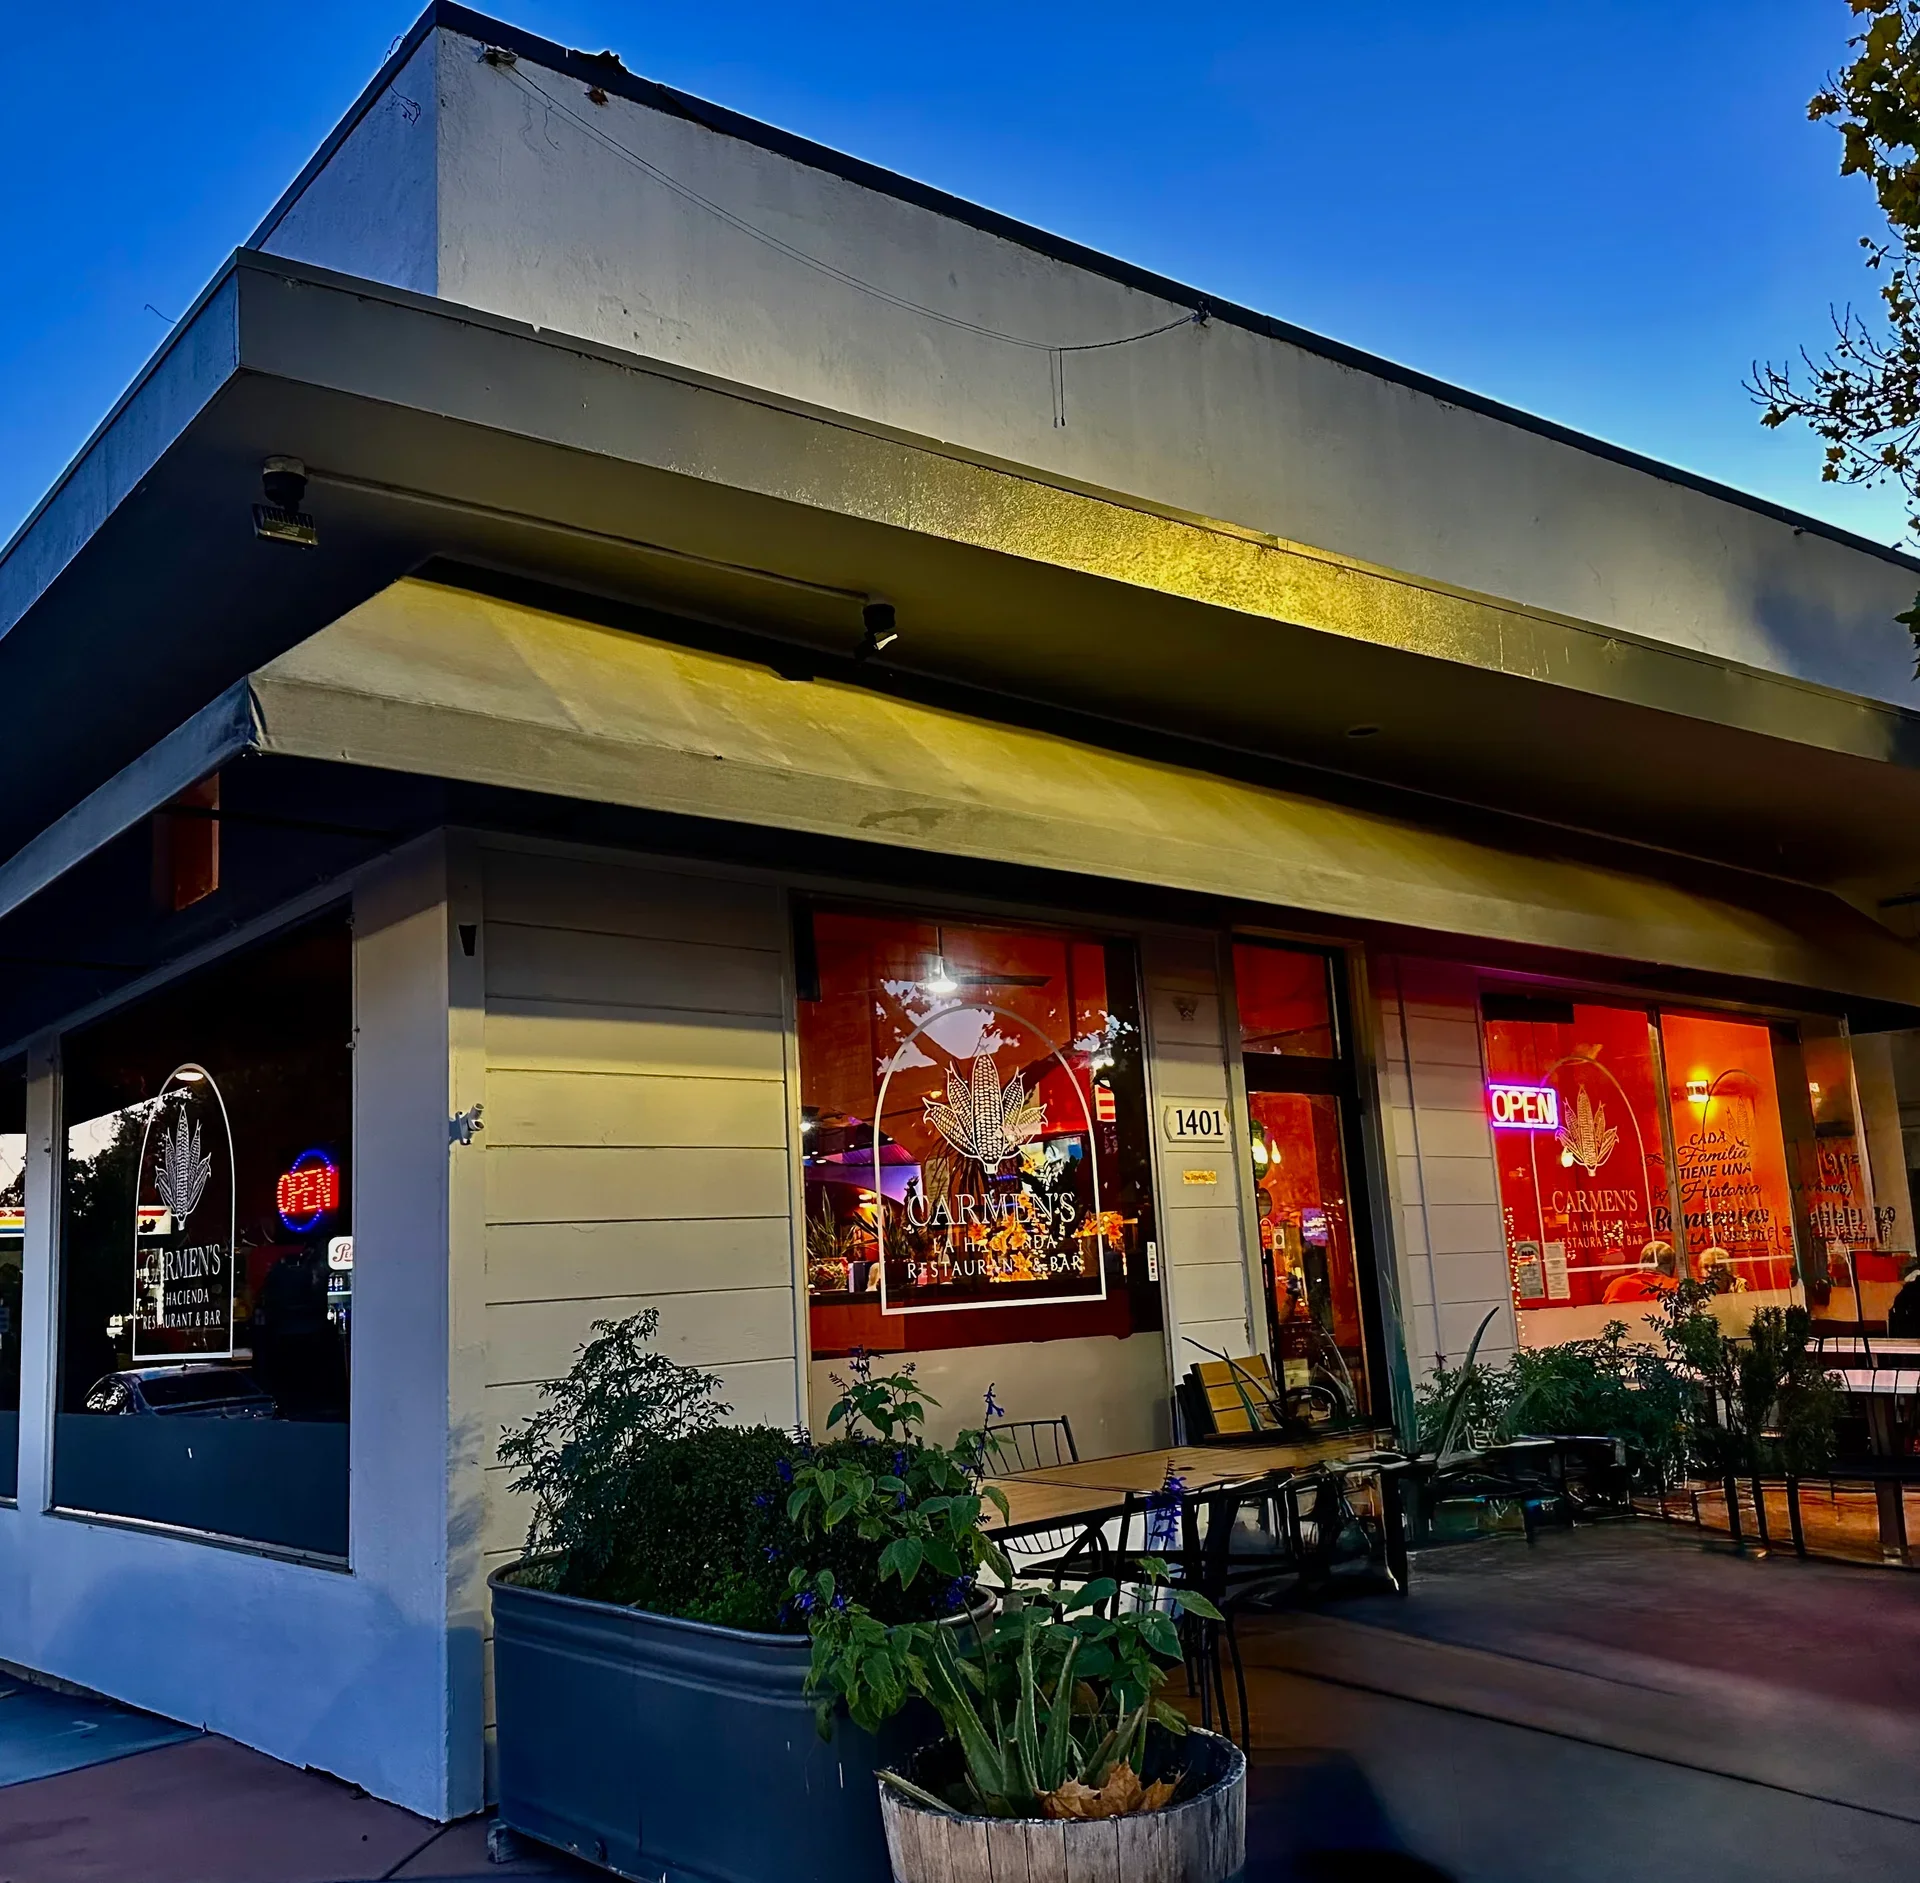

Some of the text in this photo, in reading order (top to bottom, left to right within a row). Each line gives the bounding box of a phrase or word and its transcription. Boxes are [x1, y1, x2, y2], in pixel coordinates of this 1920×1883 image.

[1492, 1090, 1554, 1124] OPEN
[1176, 1109, 1223, 1135] 1401
[1690, 1130, 1726, 1146] CADA
[1678, 1144, 1748, 1168] Familia
[1680, 1162, 1751, 1179] TIENE UNA
[277, 1168, 331, 1212] OPEN
[906, 1192, 1076, 1227] CARMEN'S
[1552, 1190, 1638, 1213] CARMEN'S
[1567, 1220, 1629, 1232] LA HACIENA
[934, 1234, 954, 1254] LA
[1626, 1235, 1643, 1246] BAR
[1051, 1254, 1082, 1272] BAR
[166, 1288, 209, 1306] HACIENDA
[143, 1310, 220, 1330] RESURANT & BAR
